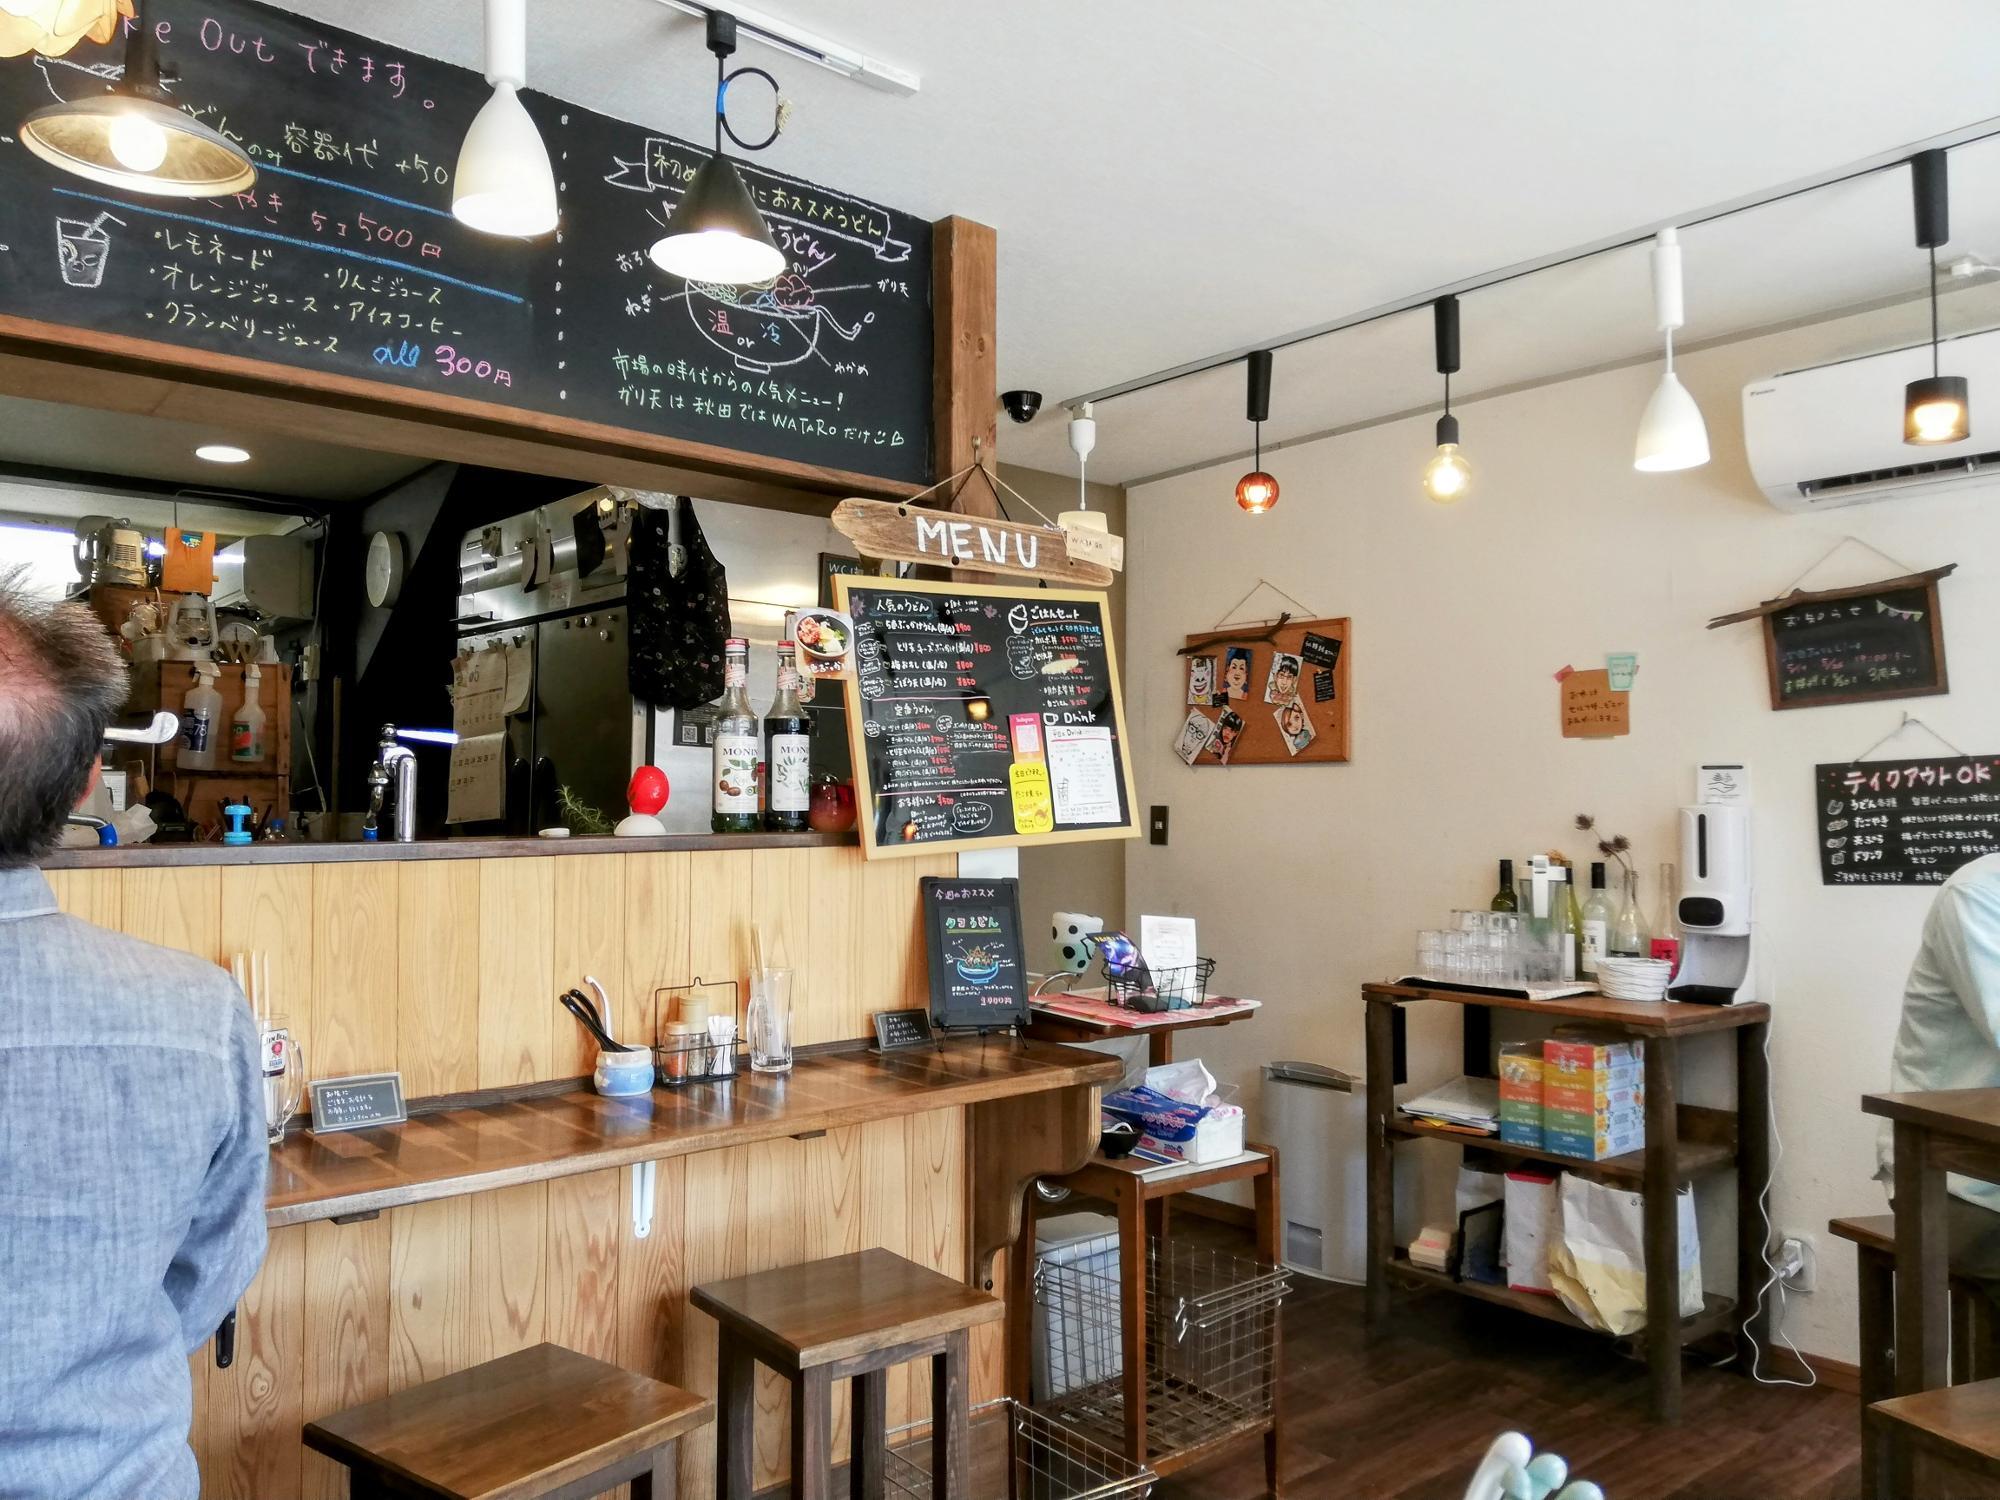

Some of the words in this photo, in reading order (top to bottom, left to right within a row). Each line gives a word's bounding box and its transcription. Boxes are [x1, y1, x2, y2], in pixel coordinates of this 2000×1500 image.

[201, 18, 274, 62] Out
[299, 40, 434, 108] できます。
[708, 309, 734, 335] 温
[736, 336, 755, 348] or
[760, 322, 782, 346] 冷
[435, 345, 512, 387] 300円
[916, 516, 1037, 568] MENU
[877, 598, 930, 613] 人気のうどん
[1030, 605, 1080, 619] ごはんセット
[1064, 710, 1096, 724] Drink
[935, 888, 995, 900] 今週のおススメ
